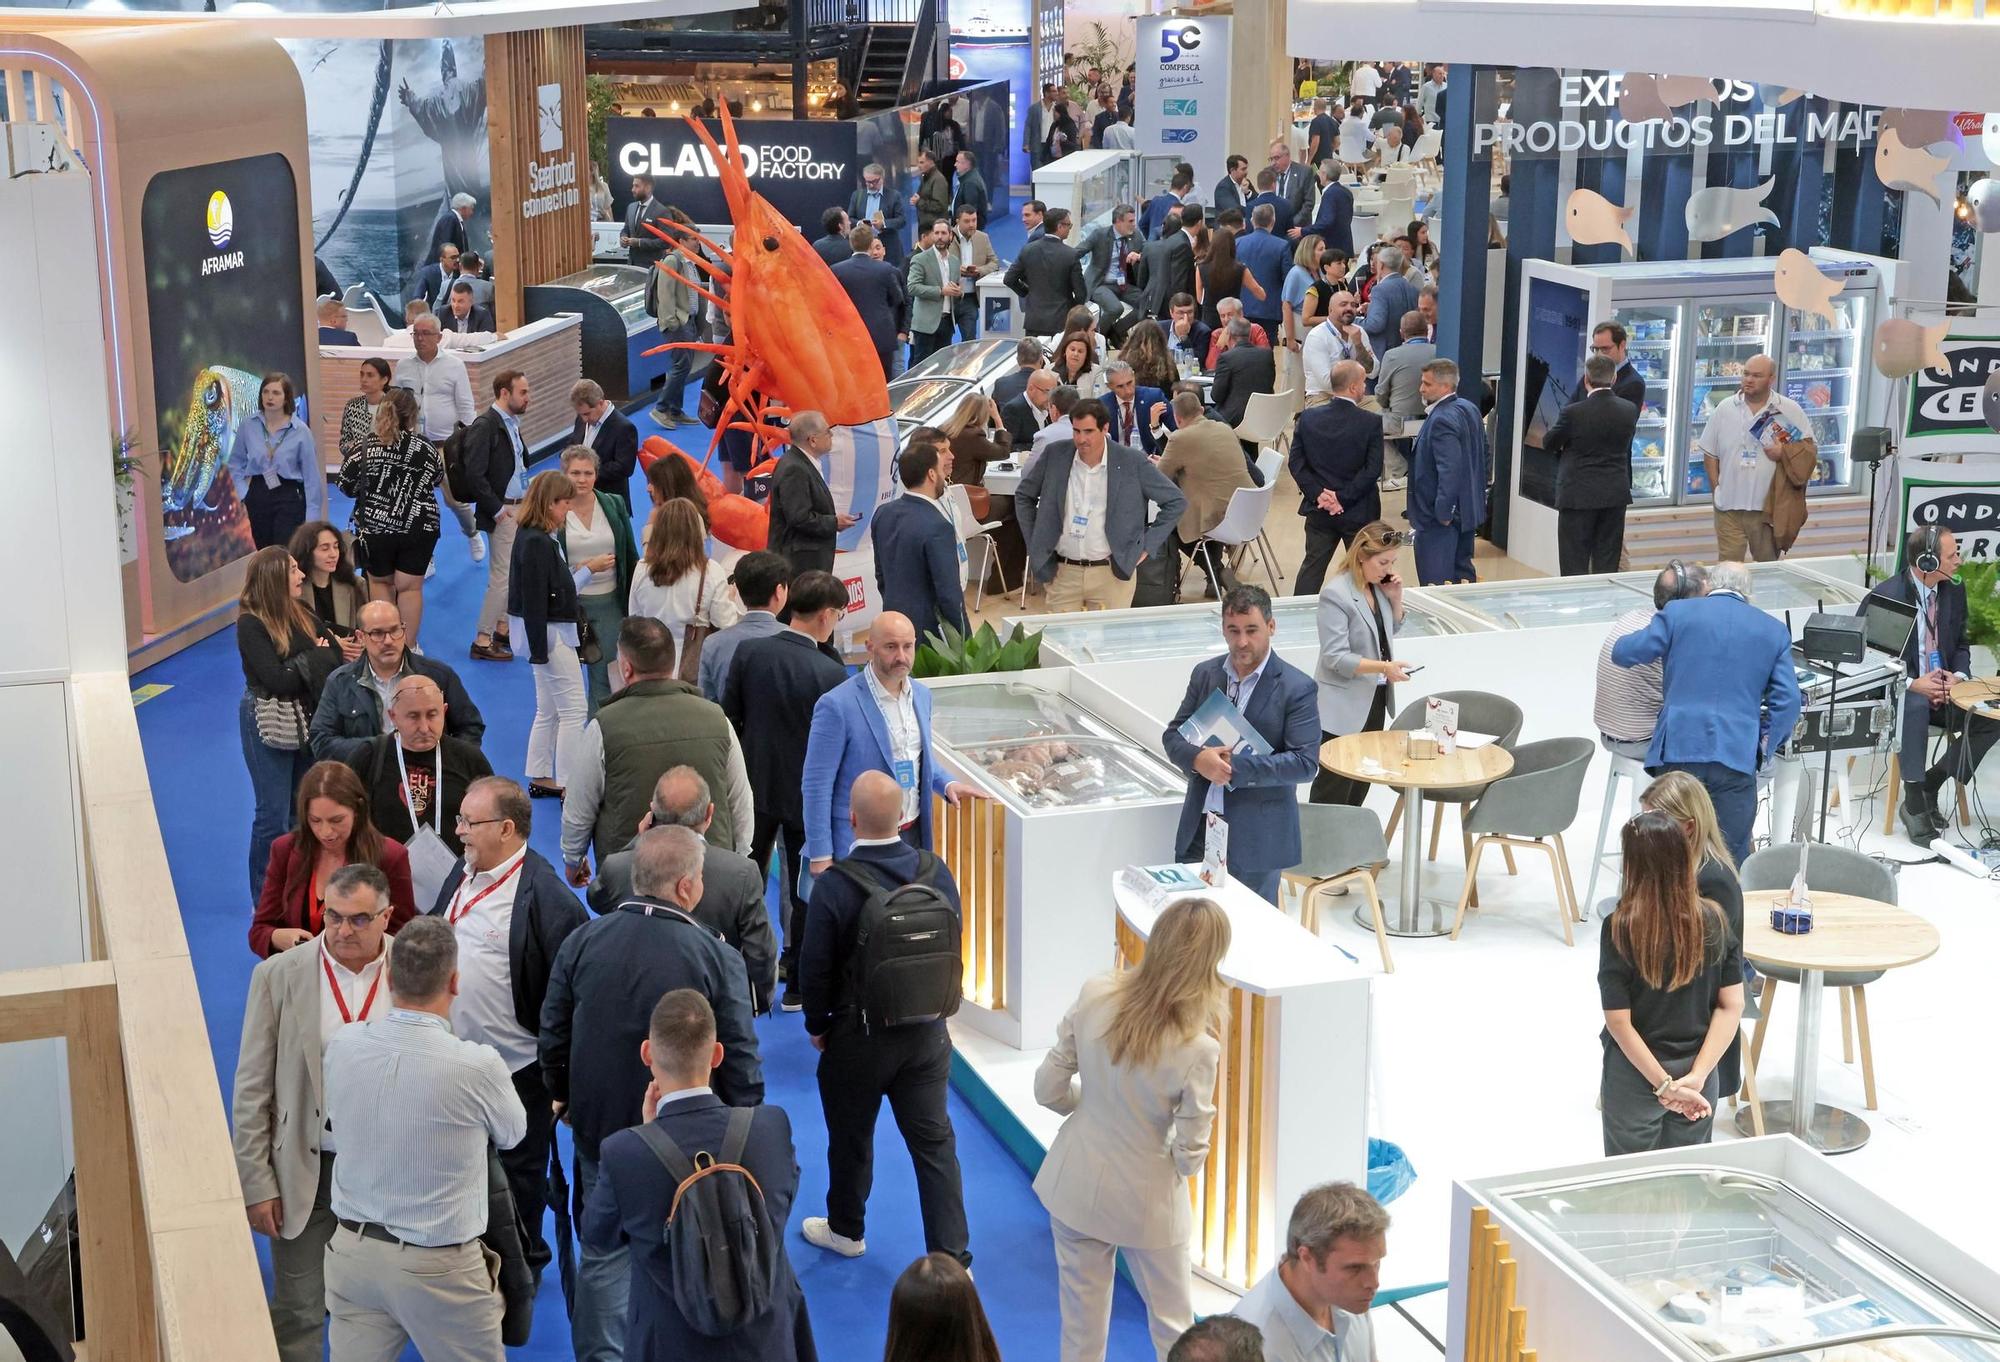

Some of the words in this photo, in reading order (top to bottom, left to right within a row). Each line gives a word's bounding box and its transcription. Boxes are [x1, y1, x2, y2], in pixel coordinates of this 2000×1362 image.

[1160, 63, 1200, 71] COMPESCA
[1474, 117, 1713, 154] PRODUCTOS
[1724, 113, 1797, 145] DEL
[760, 145, 812, 162] FOOD
[529, 152, 576, 193] Seafood
[760, 161, 845, 179] FACTORY
[523, 188, 579, 219] connection
[202, 251, 244, 276] AFRAMAR
[366, 451, 402, 460] LAGERFELD
[372, 515, 404, 527] LAGERFELD
[374, 508, 389, 518] KARL
[1923, 504, 2000, 522] OND
